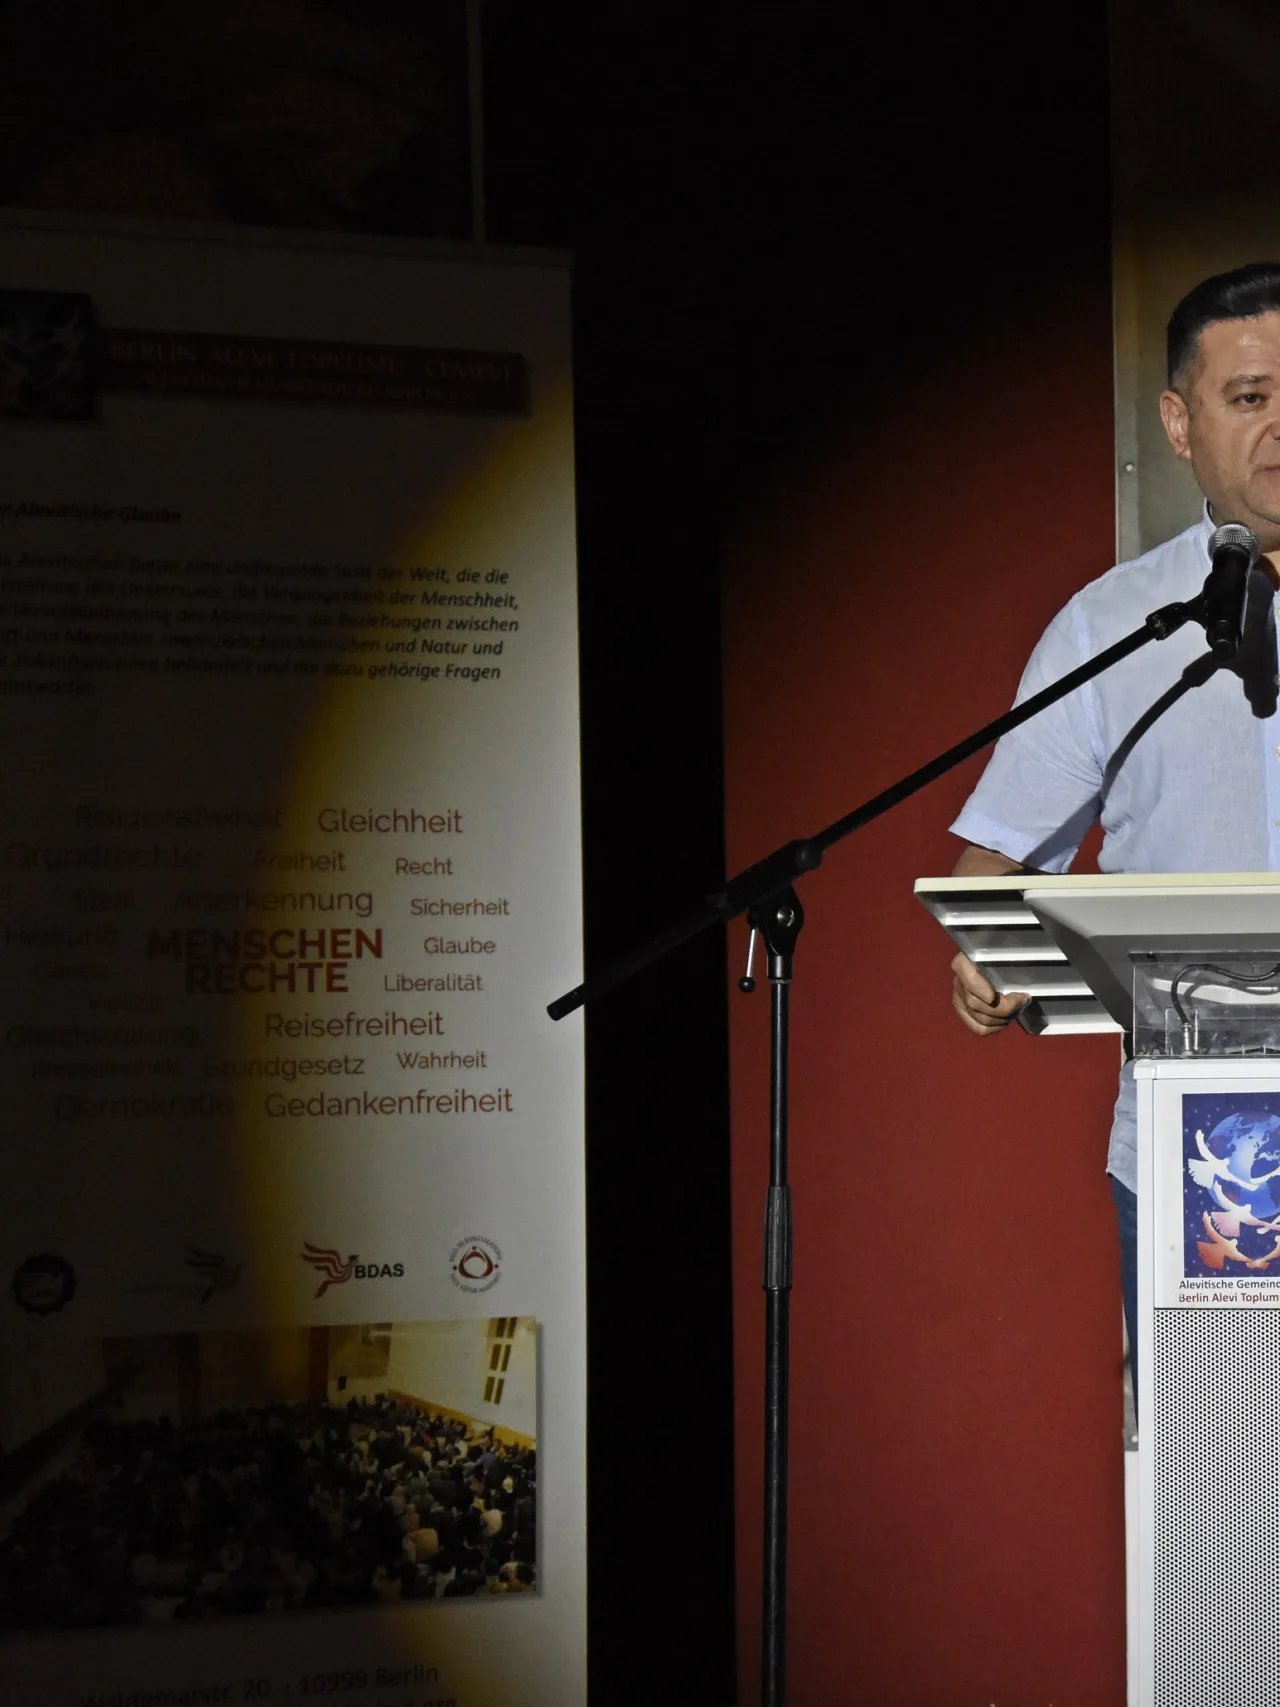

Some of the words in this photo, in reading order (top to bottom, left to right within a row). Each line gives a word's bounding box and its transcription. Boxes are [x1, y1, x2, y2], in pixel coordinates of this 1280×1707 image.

[410, 566, 450, 585] Welt,
[456, 568, 480, 584] die
[485, 568, 509, 585] die
[389, 588, 415, 604] der
[421, 590, 519, 611] Menschheit,
[338, 611, 441, 633] Beziehungen
[446, 614, 519, 633] zwischen
[385, 638, 417, 653] und
[421, 639, 468, 655] Natur
[472, 640, 504, 656] und
[325, 660, 363, 677] dazu
[368, 660, 440, 681] gehörige
[445, 662, 501, 683] Fragen
[317, 808, 464, 833] Gleichheit
[253, 849, 347, 873] Freiheit
[395, 856, 454, 876] Recht
[174, 887, 373, 918] Anerkennung
[409, 897, 511, 917] Sicherheit
[148, 927, 383, 961] MENSCHEN
[423, 936, 497, 955] Glaube
[186, 961, 349, 994] RECHTE
[383, 974, 484, 993] Liberalität
[264, 1011, 445, 1038] Reisefreiheit
[202, 1055, 365, 1082] Grundgesetz
[396, 1050, 488, 1070] Wahrheit
[264, 1088, 514, 1118] Gedankenfreiheit
[355, 1262, 404, 1279] BDAS
[1179, 1280, 1233, 1289] Alevitische
[1179, 1292, 1209, 1303] Berlin
[1212, 1292, 1238, 1302] Alevi
[243, 1677, 271, 1699] 20
[375, 1663, 439, 1687] Berlin
